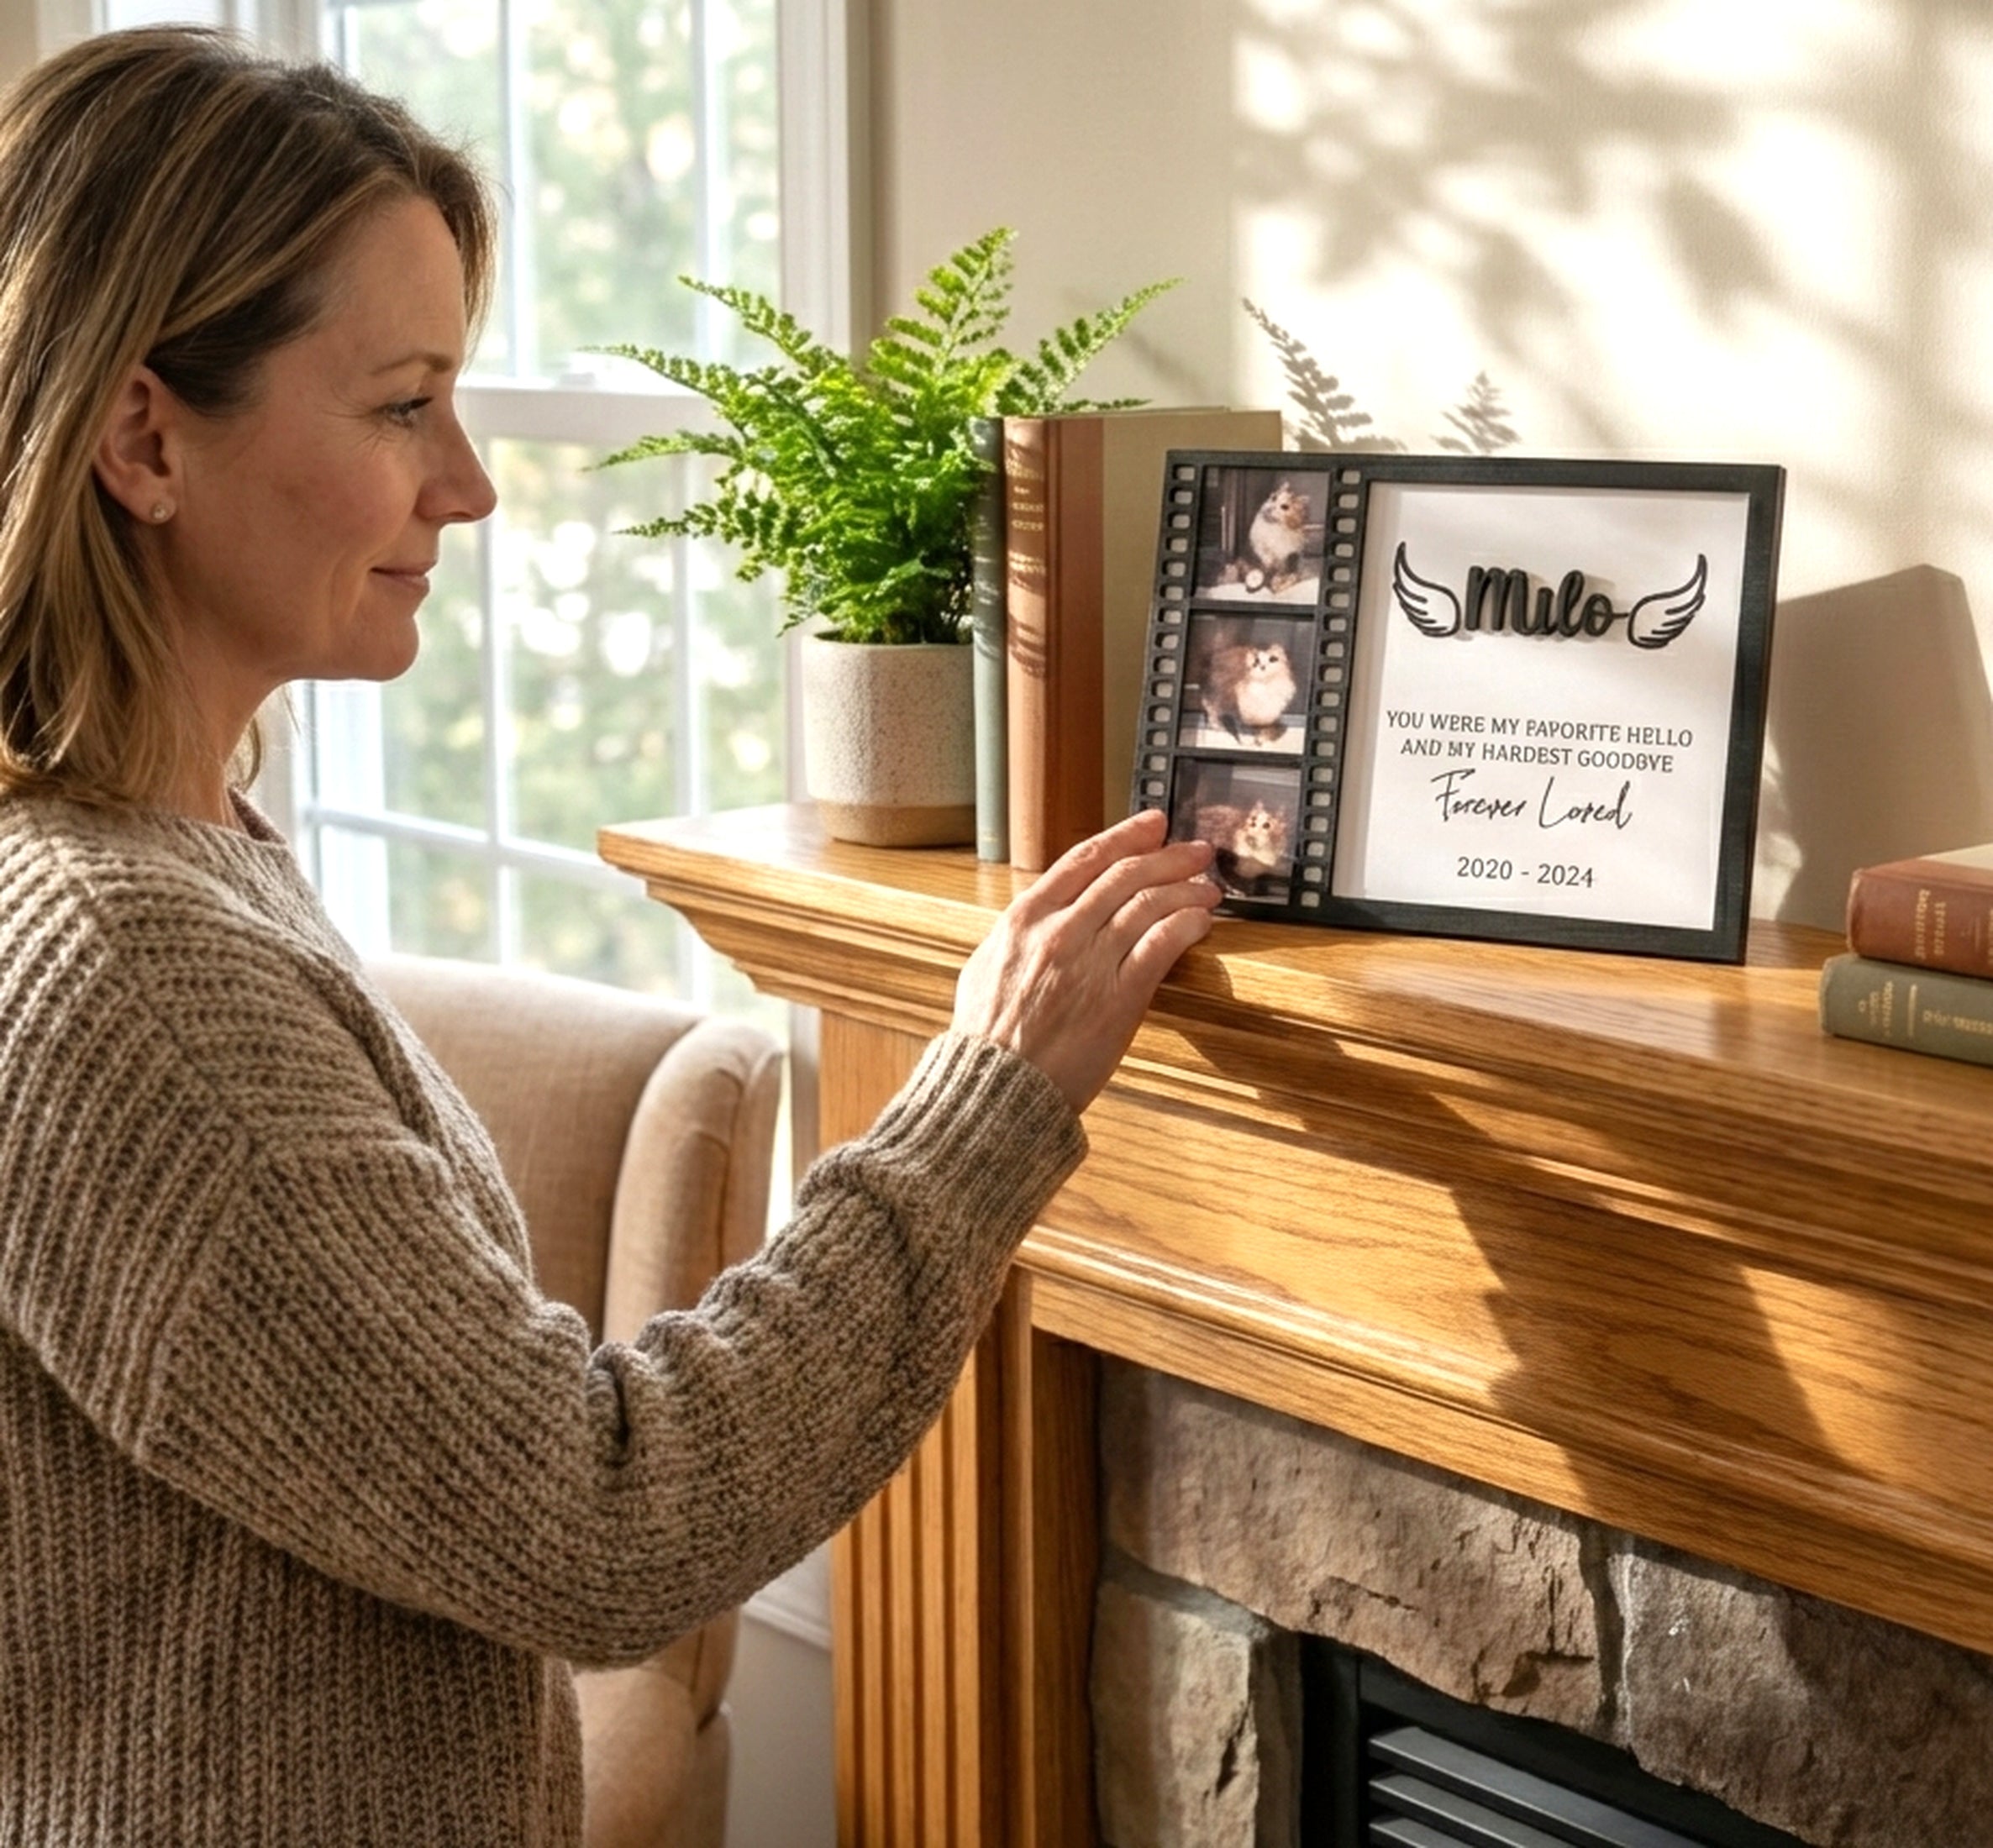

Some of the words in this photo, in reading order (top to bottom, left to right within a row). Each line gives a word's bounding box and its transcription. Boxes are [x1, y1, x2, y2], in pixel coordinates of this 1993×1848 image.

[1465, 565, 1628, 638] Milo
[1386, 710, 1424, 729] YOU
[1430, 713, 1486, 733] WERE
[1491, 717, 1520, 735] MY
[1627, 726, 1693, 748] HELLO
[1400, 738, 1443, 757] AND
[1482, 743, 1573, 765] HARDEST
[1576, 749, 1674, 773] GOODBYE
[1456, 856, 1513, 880] 2020
[1537, 863, 1594, 889] 2024
